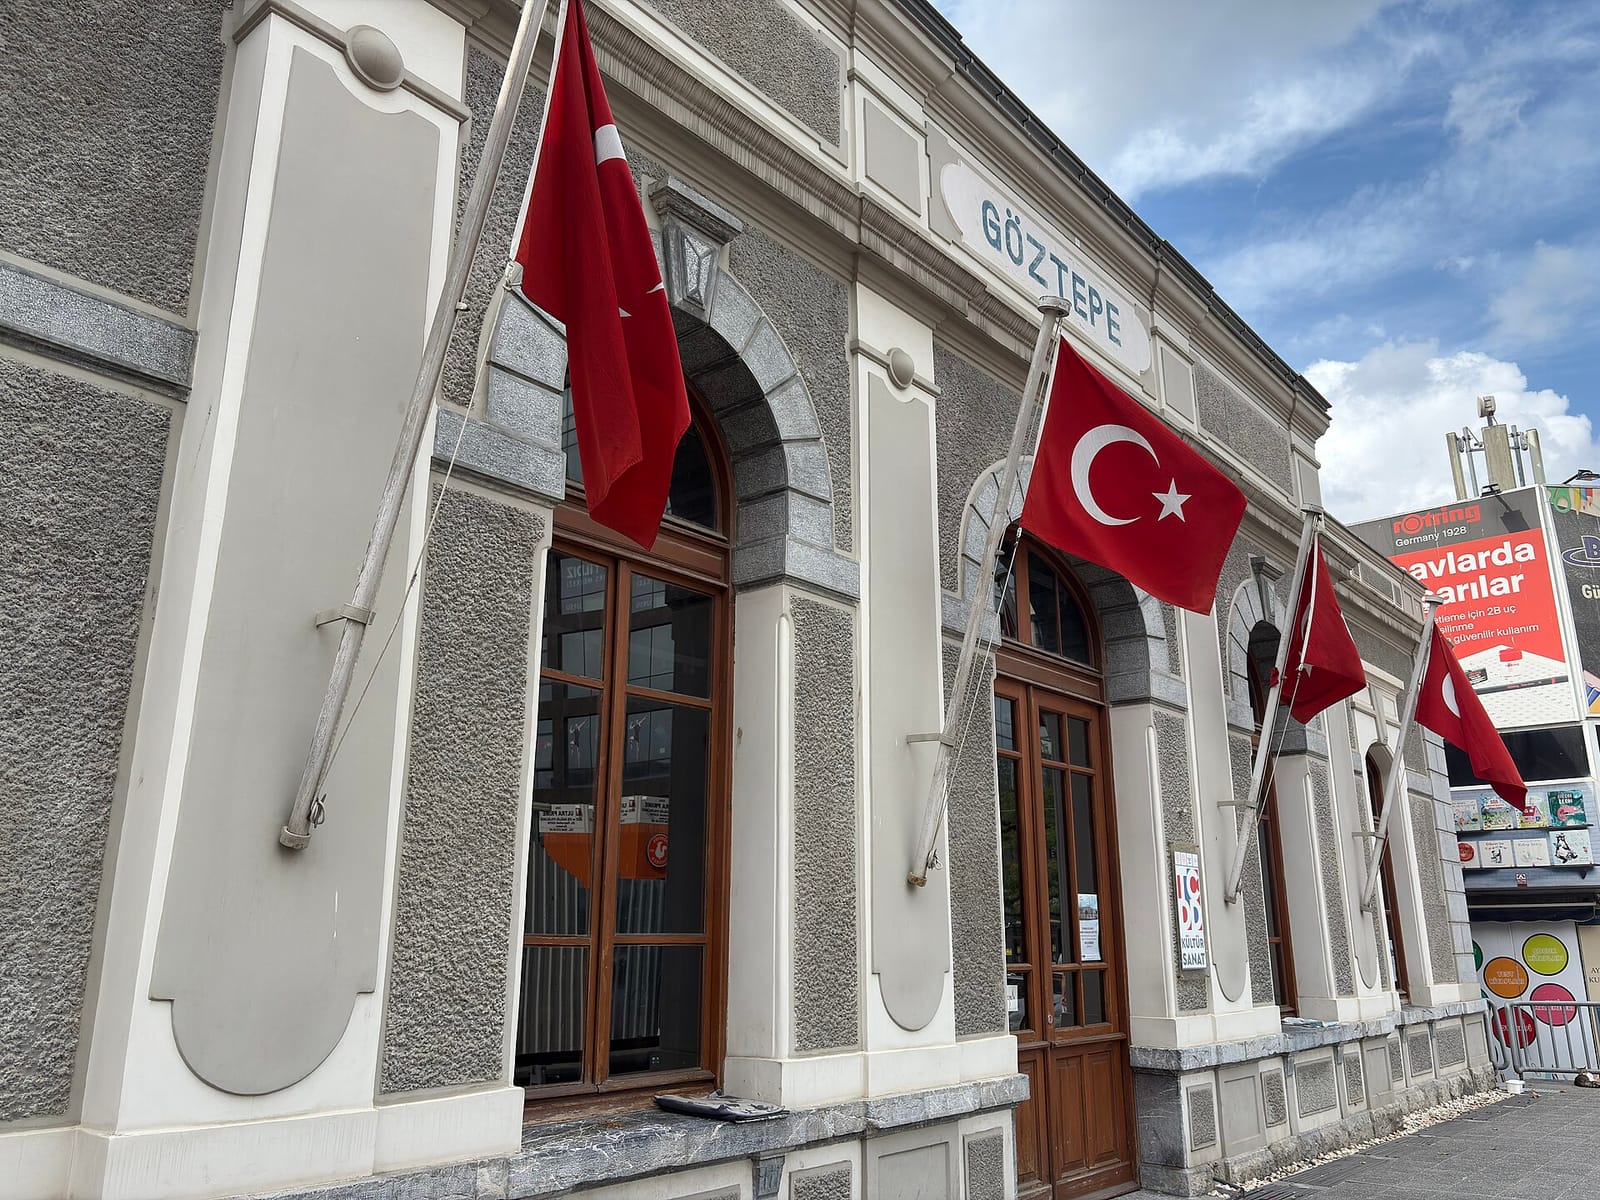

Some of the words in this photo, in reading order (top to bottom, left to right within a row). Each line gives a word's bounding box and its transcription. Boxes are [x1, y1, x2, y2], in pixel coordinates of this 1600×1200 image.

[981, 199, 1121, 347] GÖZTEPE
[1393, 504, 1481, 535] rotring
[1395, 532, 1439, 547] Germany
[1442, 526, 1467, 538] 1928
[1400, 541, 1536, 580] avlarda
[1467, 609, 1485, 621] için
[1487, 606, 1501, 616] 2B
[1503, 605, 1517, 614] uç
[1453, 630, 1495, 645] güvenilir
[1496, 624, 1539, 637] kullanım
[1181, 934, 1205, 949] KÜLTÜR
[1182, 952, 1205, 966] SANAT
